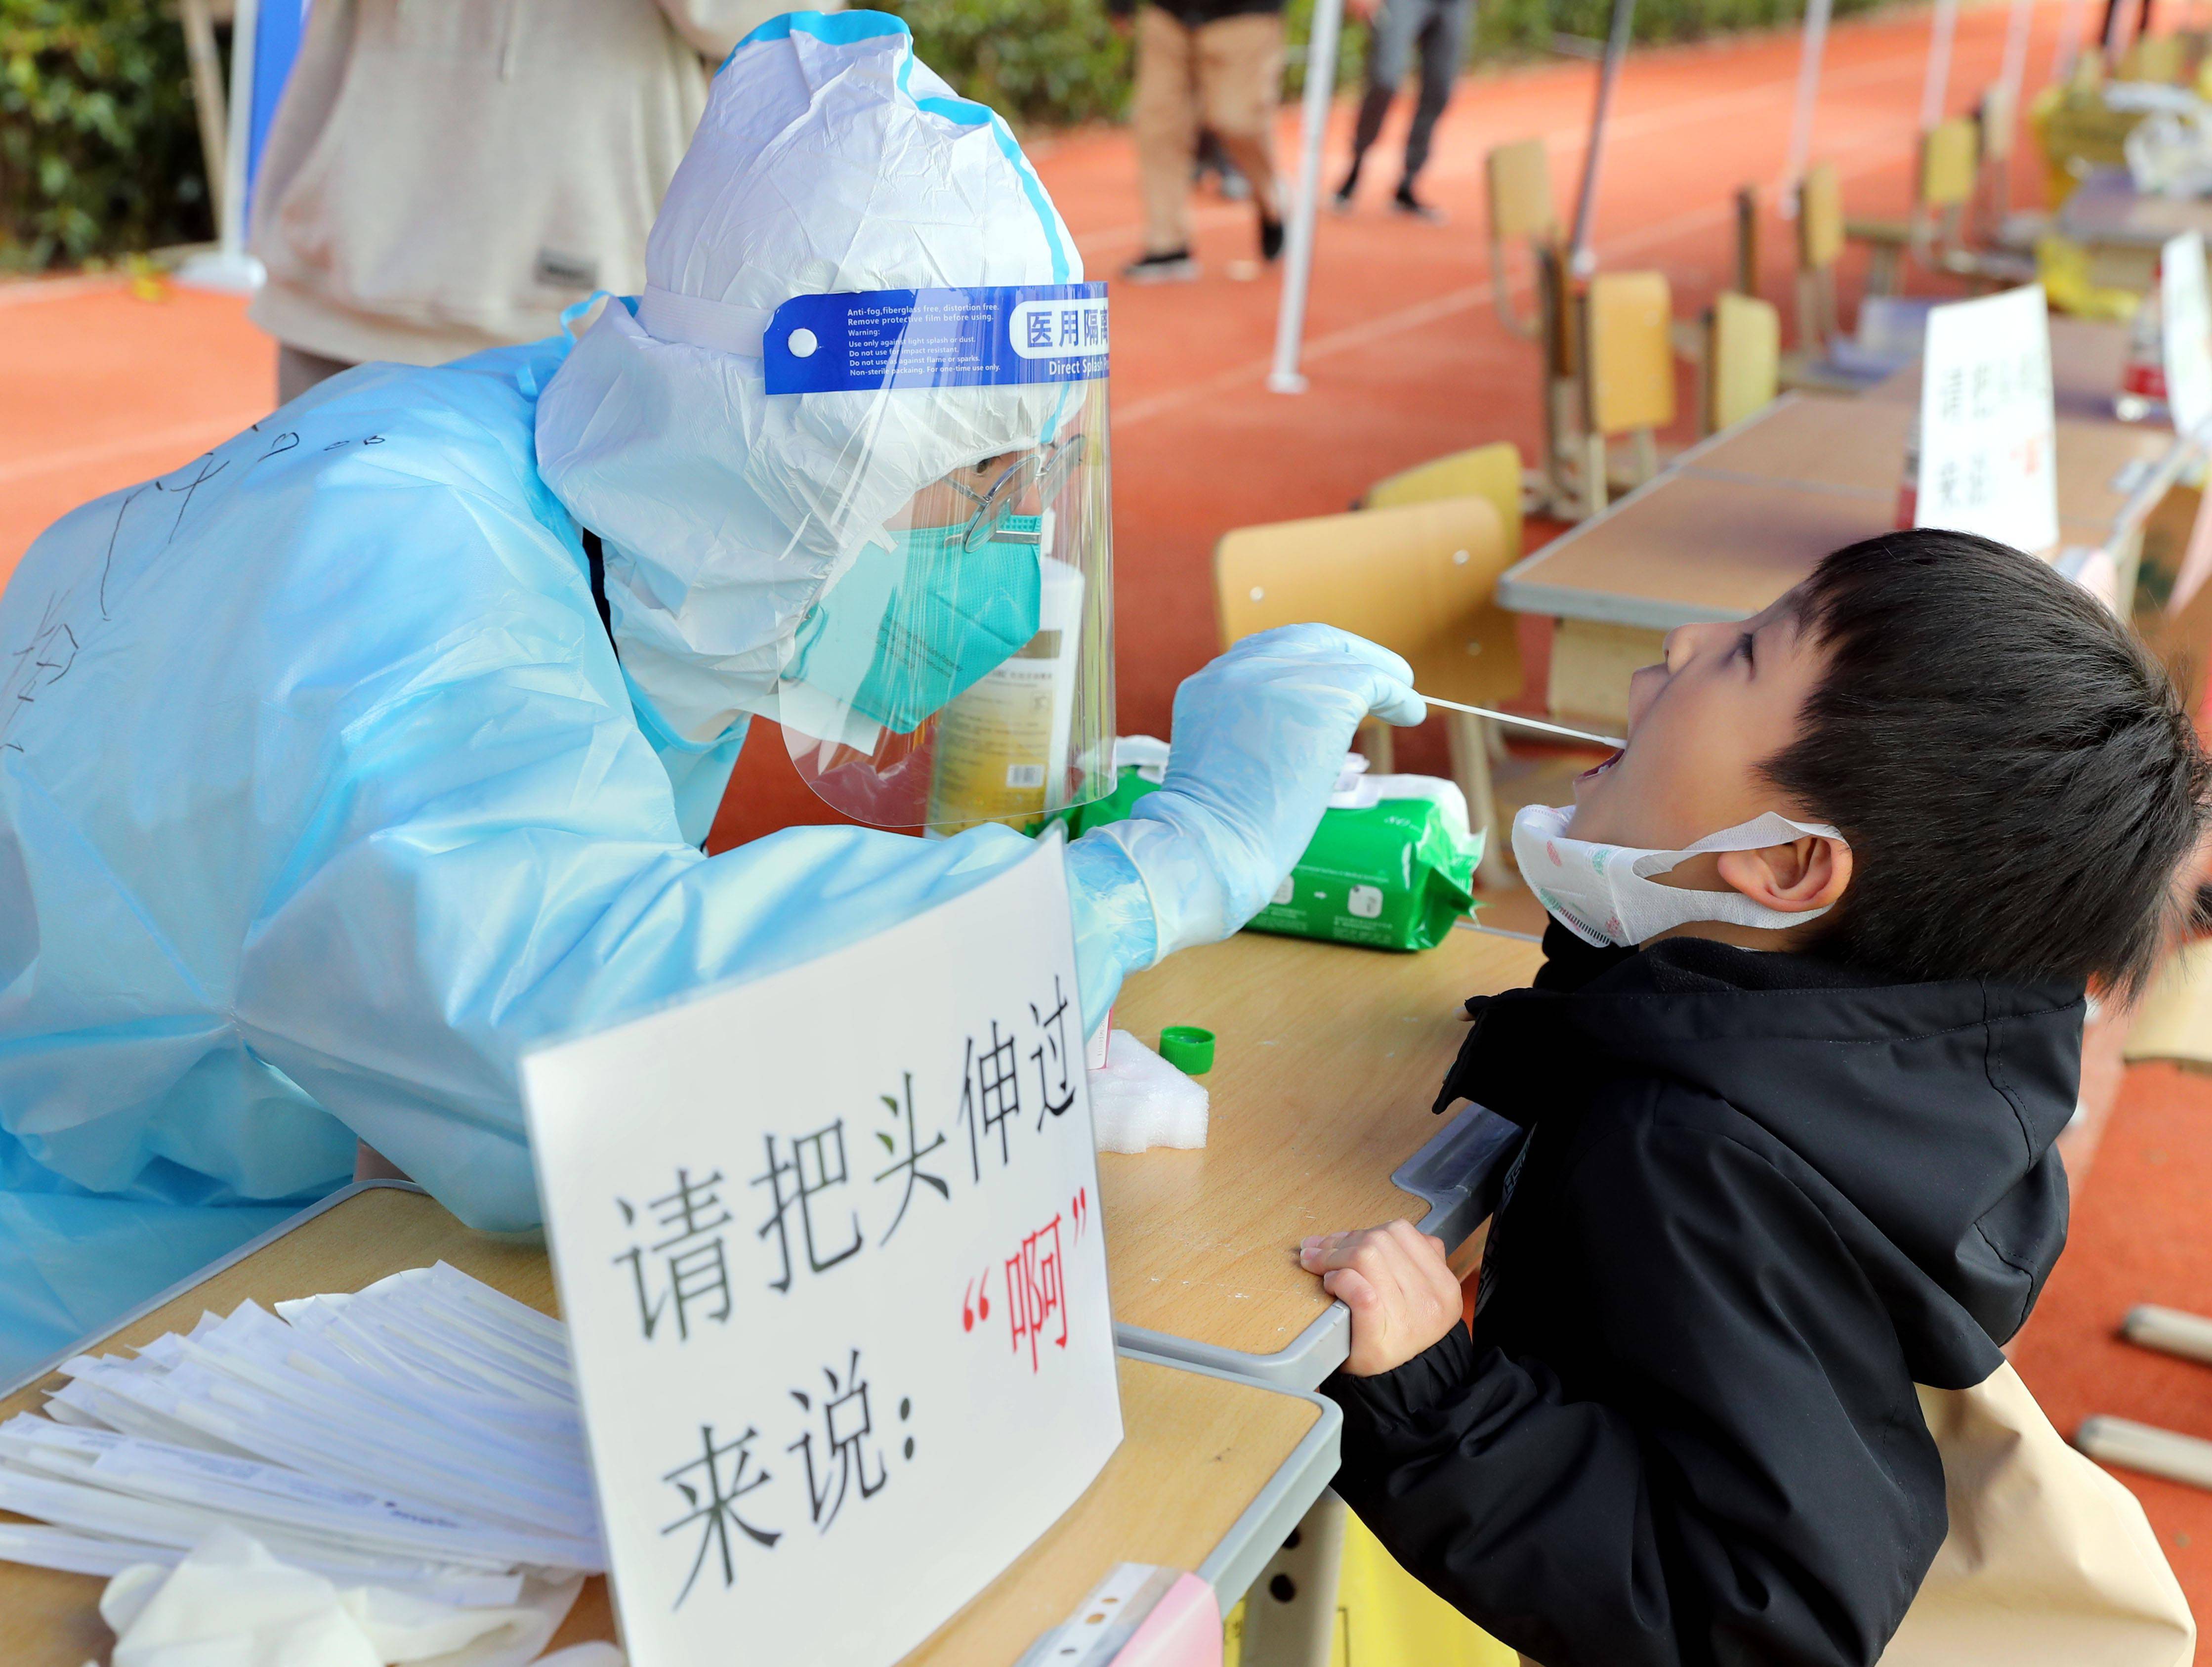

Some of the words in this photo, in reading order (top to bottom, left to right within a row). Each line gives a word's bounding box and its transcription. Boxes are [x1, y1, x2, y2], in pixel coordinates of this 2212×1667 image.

[847, 305, 921, 316] Anti-fog,fiberglass
[983, 302, 999, 311] free.
[848, 318, 879, 326] Remove
[882, 315, 922, 326] protective
[971, 313, 994, 322] using.
[864, 340, 879, 348] only
[880, 338, 906, 347] against
[926, 337, 948, 345] splash
[902, 347, 925, 355] impact
[899, 357, 924, 366] against
[957, 355, 980, 364] sparks.
[850, 367, 889, 376] Non-sterile
[891, 367, 925, 376] packaing.
[985, 364, 1001, 372] only.
[1049, 360, 1080, 376] Direct
[1082, 357, 1103, 377] Splash
[613, 975, 1077, 1341] 请把头伸过
